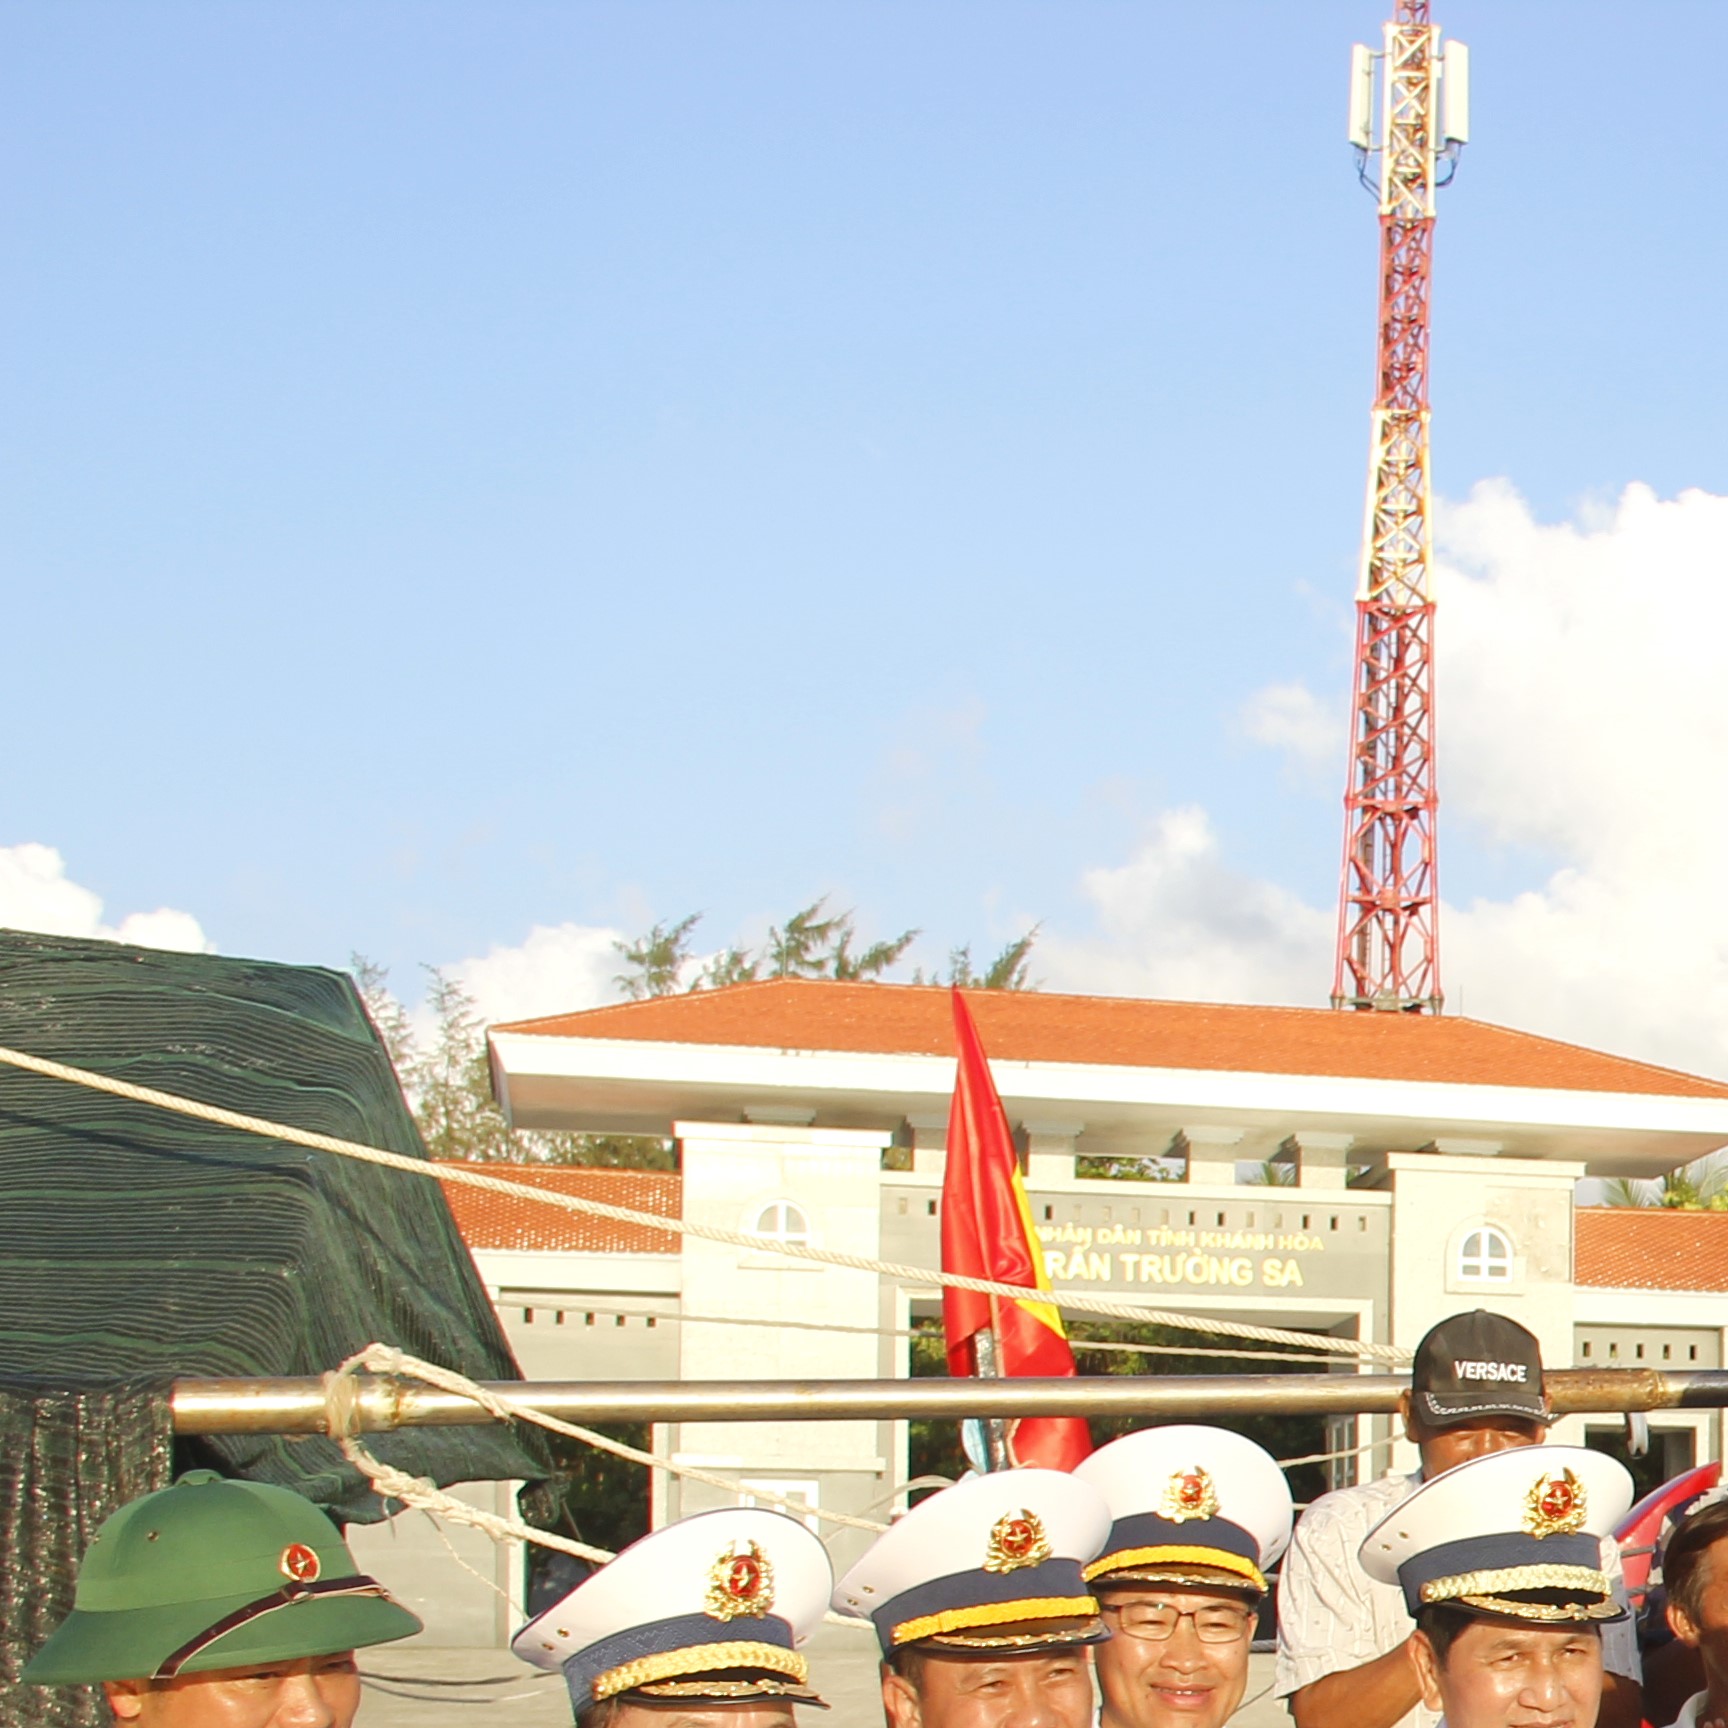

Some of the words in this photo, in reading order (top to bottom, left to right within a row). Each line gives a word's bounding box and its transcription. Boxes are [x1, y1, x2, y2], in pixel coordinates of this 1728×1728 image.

[1097, 1224, 1142, 1245] DÂN
[1198, 1227, 1274, 1250] KHÁNH
[1279, 1231, 1324, 1251] HÒA
[1042, 1242, 1111, 1282] RẤN
[1120, 1248, 1253, 1286] TRƯỜNG
[1262, 1258, 1304, 1287] SA
[1454, 1360, 1527, 1383] VERSACE
